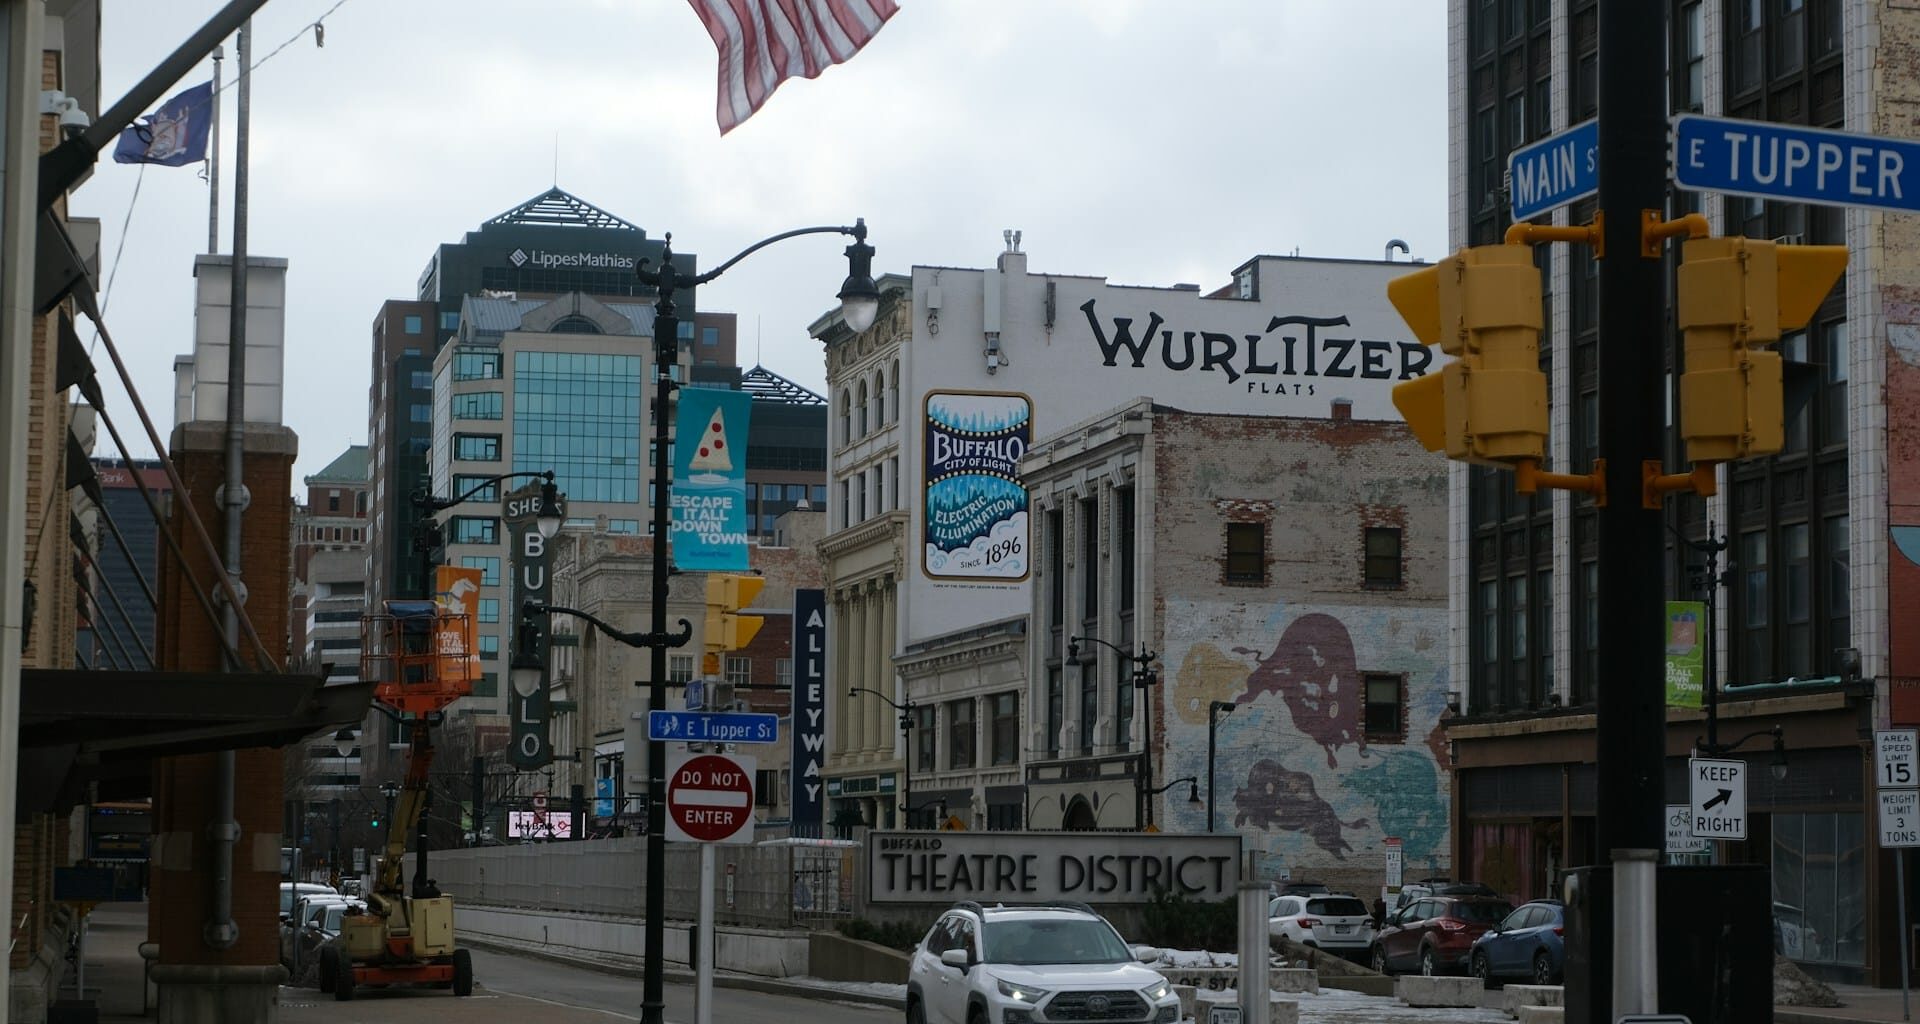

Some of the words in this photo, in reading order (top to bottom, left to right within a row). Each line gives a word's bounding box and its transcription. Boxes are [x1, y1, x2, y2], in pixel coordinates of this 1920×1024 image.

[1689, 138, 1705, 168] E
[1723, 131, 1904, 200] TUPPER
[1517, 140, 1576, 209] MAIN
[1586, 146, 1599, 173] S
[531, 250, 634, 269] LippesMathias
[1079, 299, 1433, 384] WURLITZER
[1247, 382, 1315, 396] FLATS
[932, 430, 1024, 466] BUFFALO
[944, 458, 967, 471] CITY
[969, 458, 981, 467] OF
[982, 457, 1012, 473] LIGHT
[671, 495, 733, 509] ESCAPE
[683, 508, 698, 520] IT
[699, 508, 729, 521] ALL
[935, 495, 988, 526] ELECTRIC
[671, 520, 722, 533] DOWN
[935, 499, 1015, 540] ILLUMINATION
[698, 532, 748, 545] TOWN
[960, 558, 982, 569] SINCE
[985, 536, 1022, 565] 1896
[801, 608, 825, 803] ALLEYWAY
[687, 720, 696, 736] E
[701, 717, 752, 740] Tupper
[1883, 734, 1910, 743] AREA
[1881, 744, 1913, 752] SPEED
[1885, 754, 1909, 762] LIMIT
[681, 770, 702, 785] DO
[711, 772, 742, 786] NOT
[1700, 766, 1738, 782] KEEP
[1885, 763, 1911, 783] 15
[1882, 794, 1917, 804] WEIGHT
[685, 809, 733, 825] ENTER
[1887, 805, 1912, 815] LIMIT
[1696, 816, 1742, 833] RIGHT
[1896, 817, 1905, 828] 3
[1668, 829, 1682, 838] MAY
[1885, 831, 1917, 842] TONS
[881, 838, 942, 850] BUFFALO
[1685, 840, 1702, 849] LANE
[881, 853, 1038, 892] THEATRE
[1059, 854, 1231, 893] DISTRICT
